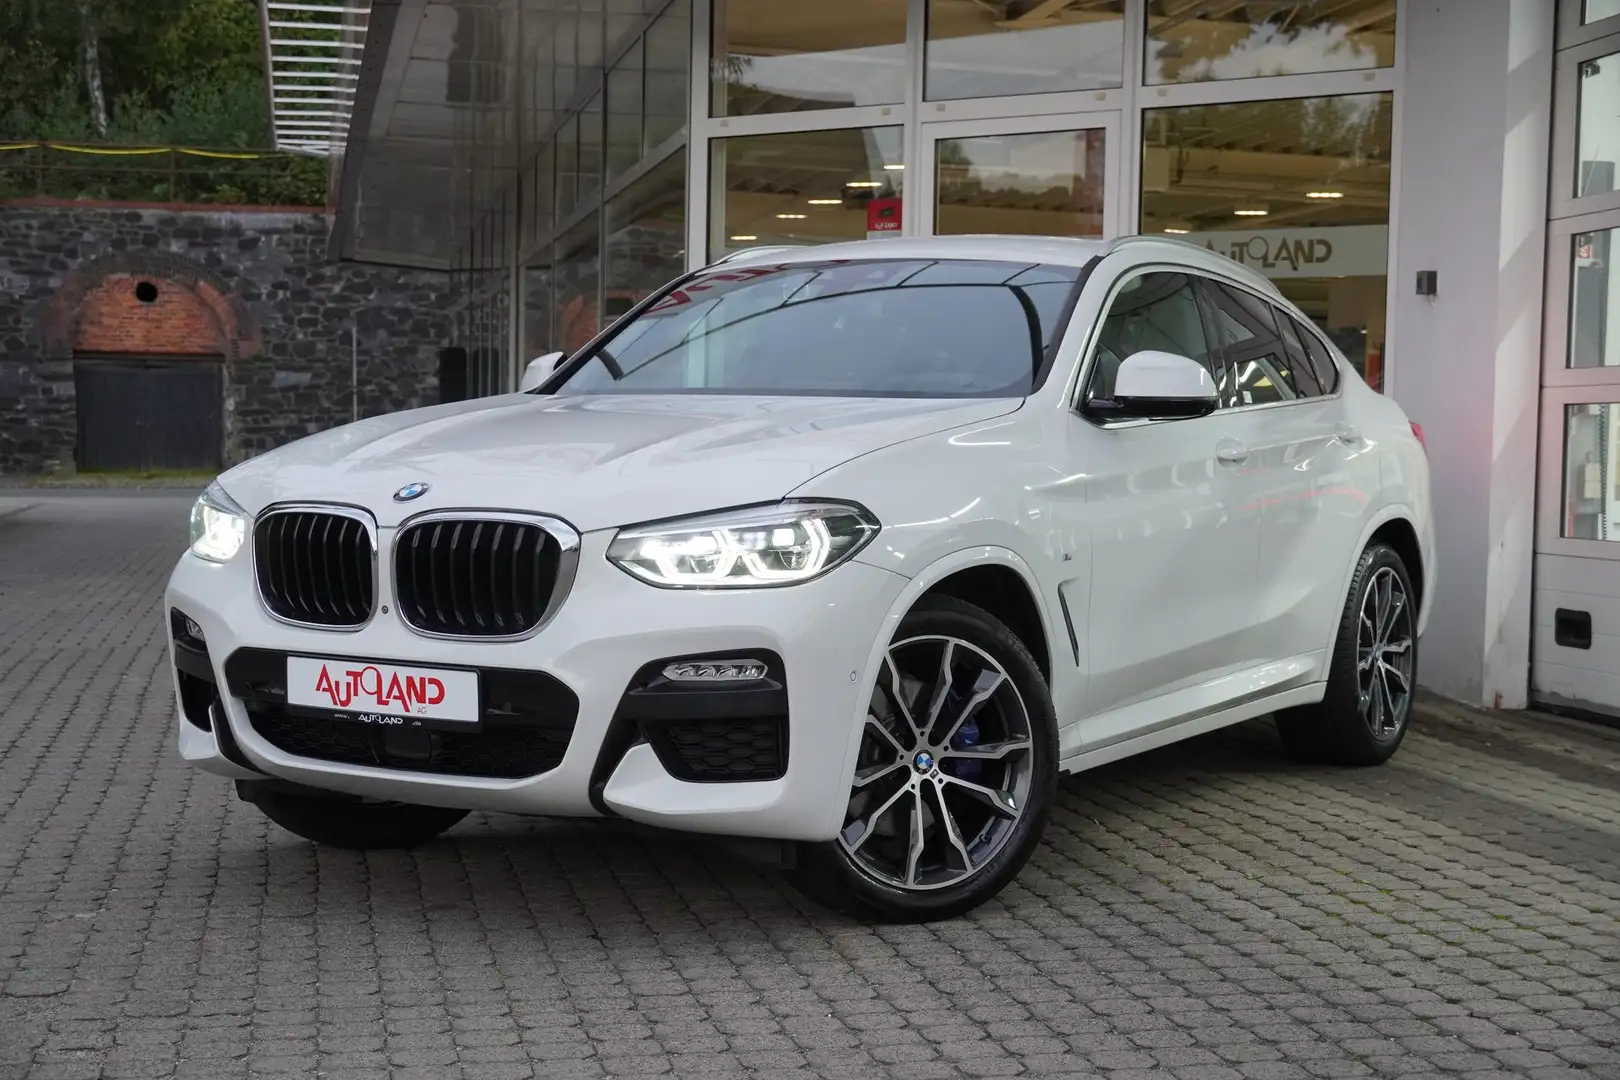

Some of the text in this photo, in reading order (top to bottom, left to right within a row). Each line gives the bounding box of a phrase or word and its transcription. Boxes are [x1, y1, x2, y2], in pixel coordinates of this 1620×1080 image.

[315, 663, 446, 713] AUTOLAND
[416, 706, 427, 715] AG
[358, 713, 404, 725] AUTOLAND
